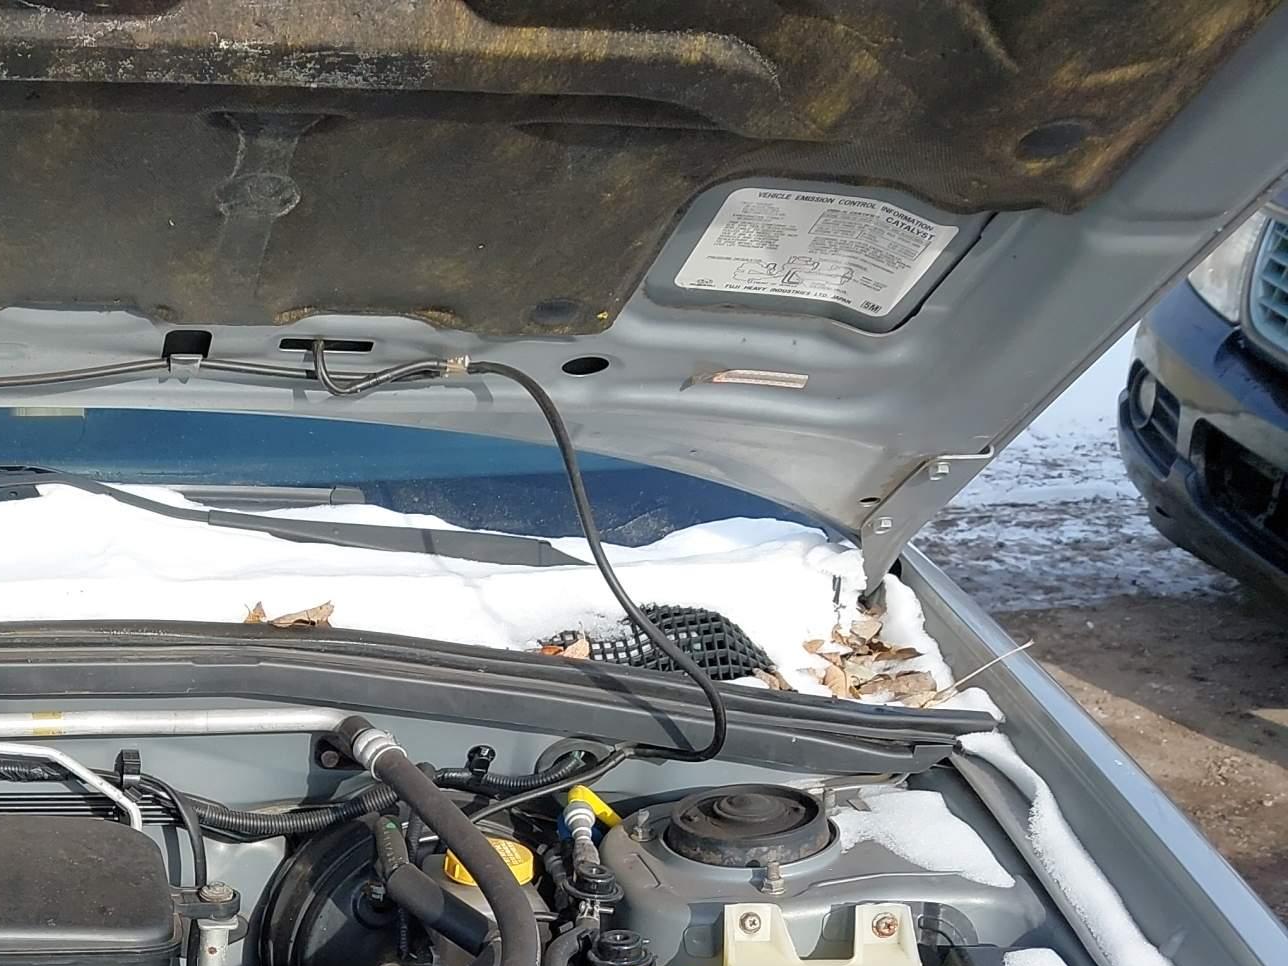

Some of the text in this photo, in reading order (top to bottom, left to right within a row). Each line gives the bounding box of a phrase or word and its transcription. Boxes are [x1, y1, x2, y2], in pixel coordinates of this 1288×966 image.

[758, 191, 934, 231] VEHICLE EMISSION CONTROL INFORMATION
[885, 216, 935, 241] CATALYST
